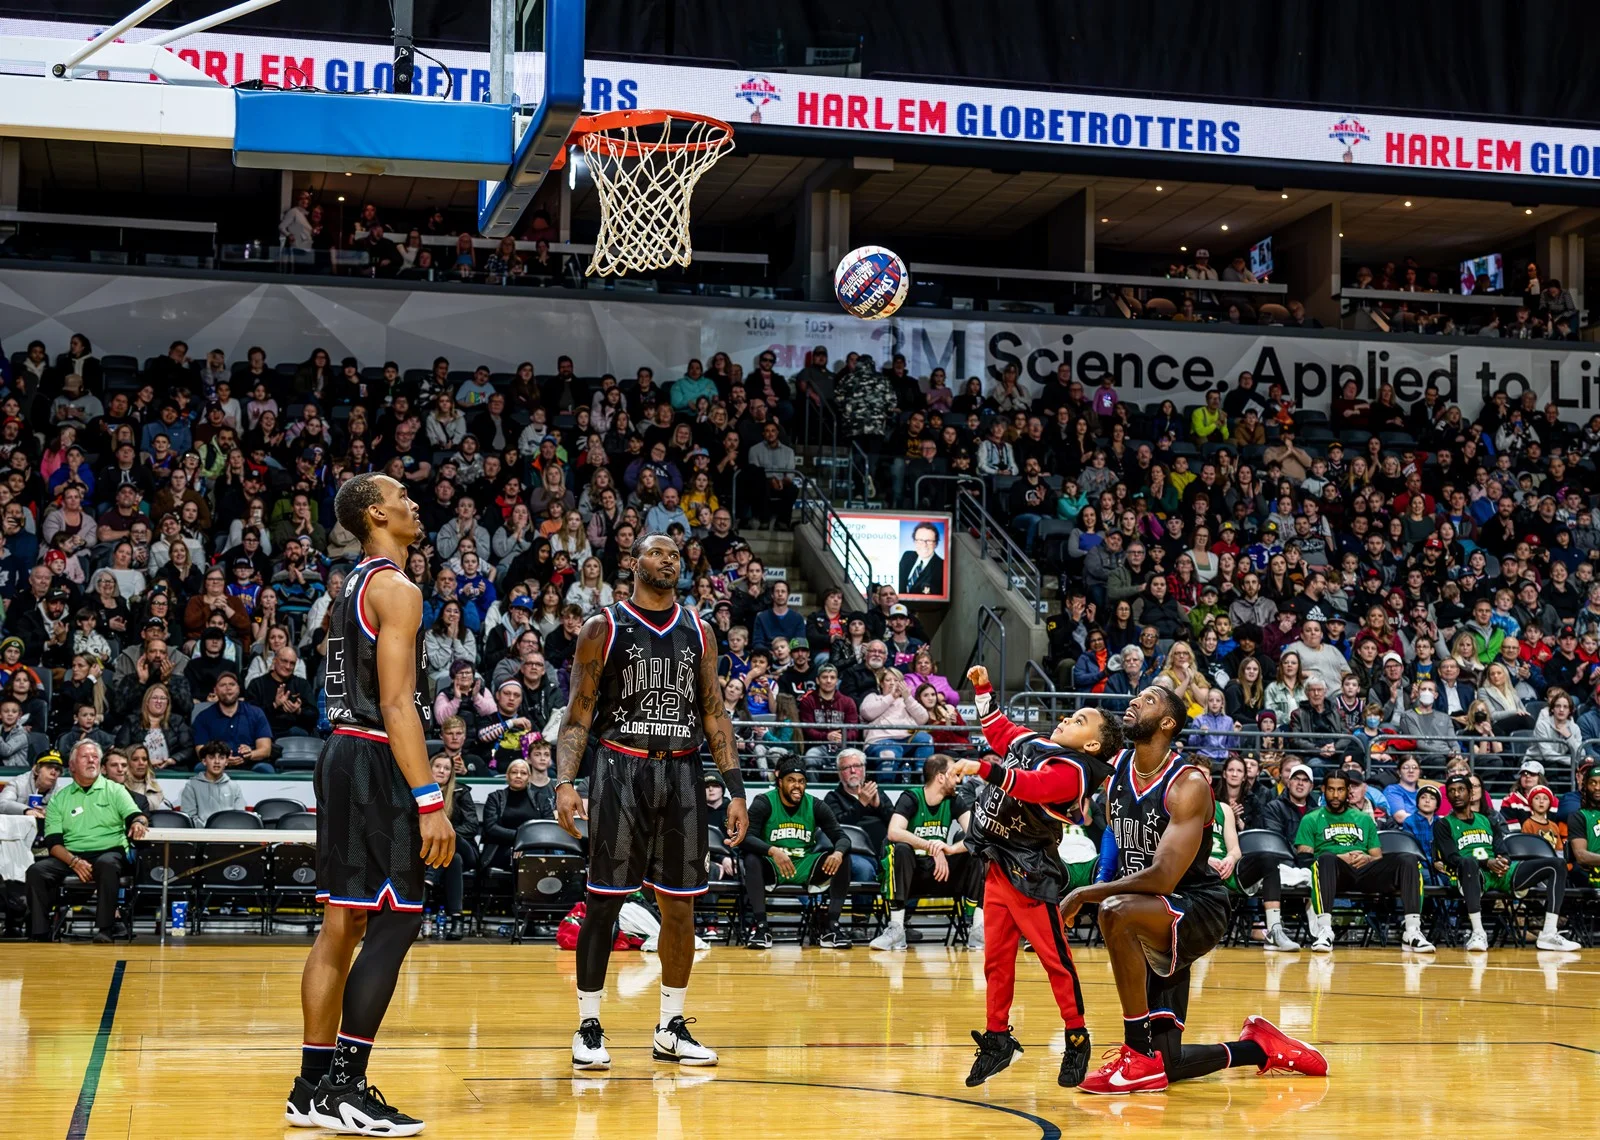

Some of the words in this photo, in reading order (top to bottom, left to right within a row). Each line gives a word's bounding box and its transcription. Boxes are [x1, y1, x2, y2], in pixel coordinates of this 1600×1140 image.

[150, 47, 313, 89] ARLEM
[798, 91, 946, 134] HARLEM
[956, 102, 1240, 153] GLOBETROTTERS
[1386, 132, 1521, 171] HARLEM
[854, 274, 894, 315] SPALDING
[987, 331, 1229, 393] Science.
[1253, 346, 1458, 409] Applied
[1475, 361, 1532, 400] to
[621, 657, 695, 704] HARLEM
[640, 690, 681, 722] 42
[620, 721, 691, 739] GLOBETROTTERS
[770, 828, 812, 842] GENERALS
[1113, 817, 1161, 856] ARLE
[1324, 827, 1363, 842] GENERALS
[1458, 833, 1493, 850] GENERALS
